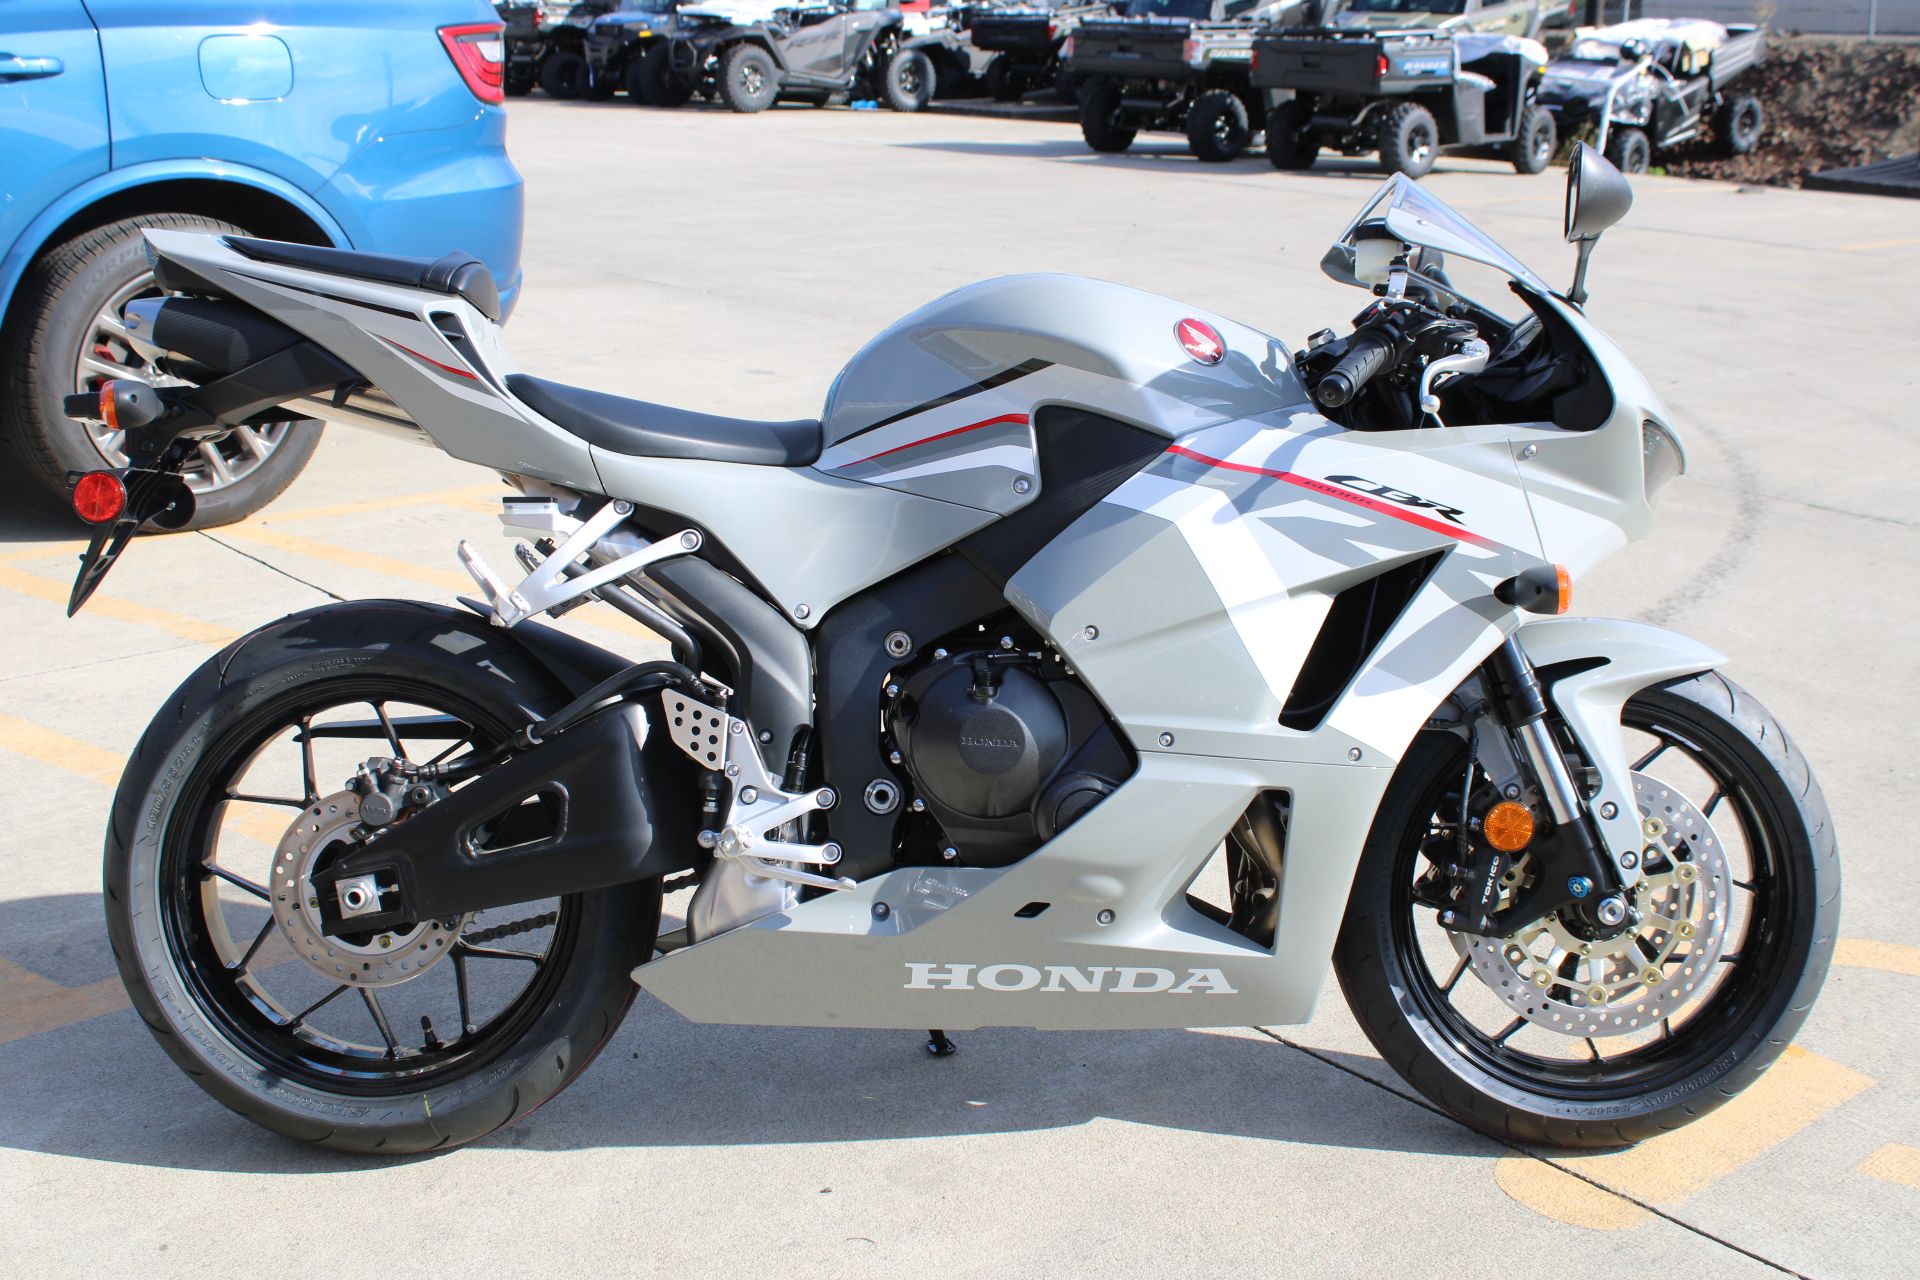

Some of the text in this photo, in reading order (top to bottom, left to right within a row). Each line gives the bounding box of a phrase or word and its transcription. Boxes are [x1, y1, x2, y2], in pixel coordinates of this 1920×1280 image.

[1323, 474, 1467, 527] CBR
[961, 735, 1018, 749] HONDA
[1481, 855, 1500, 904] TOKICO
[903, 962, 1239, 995] HONDA
